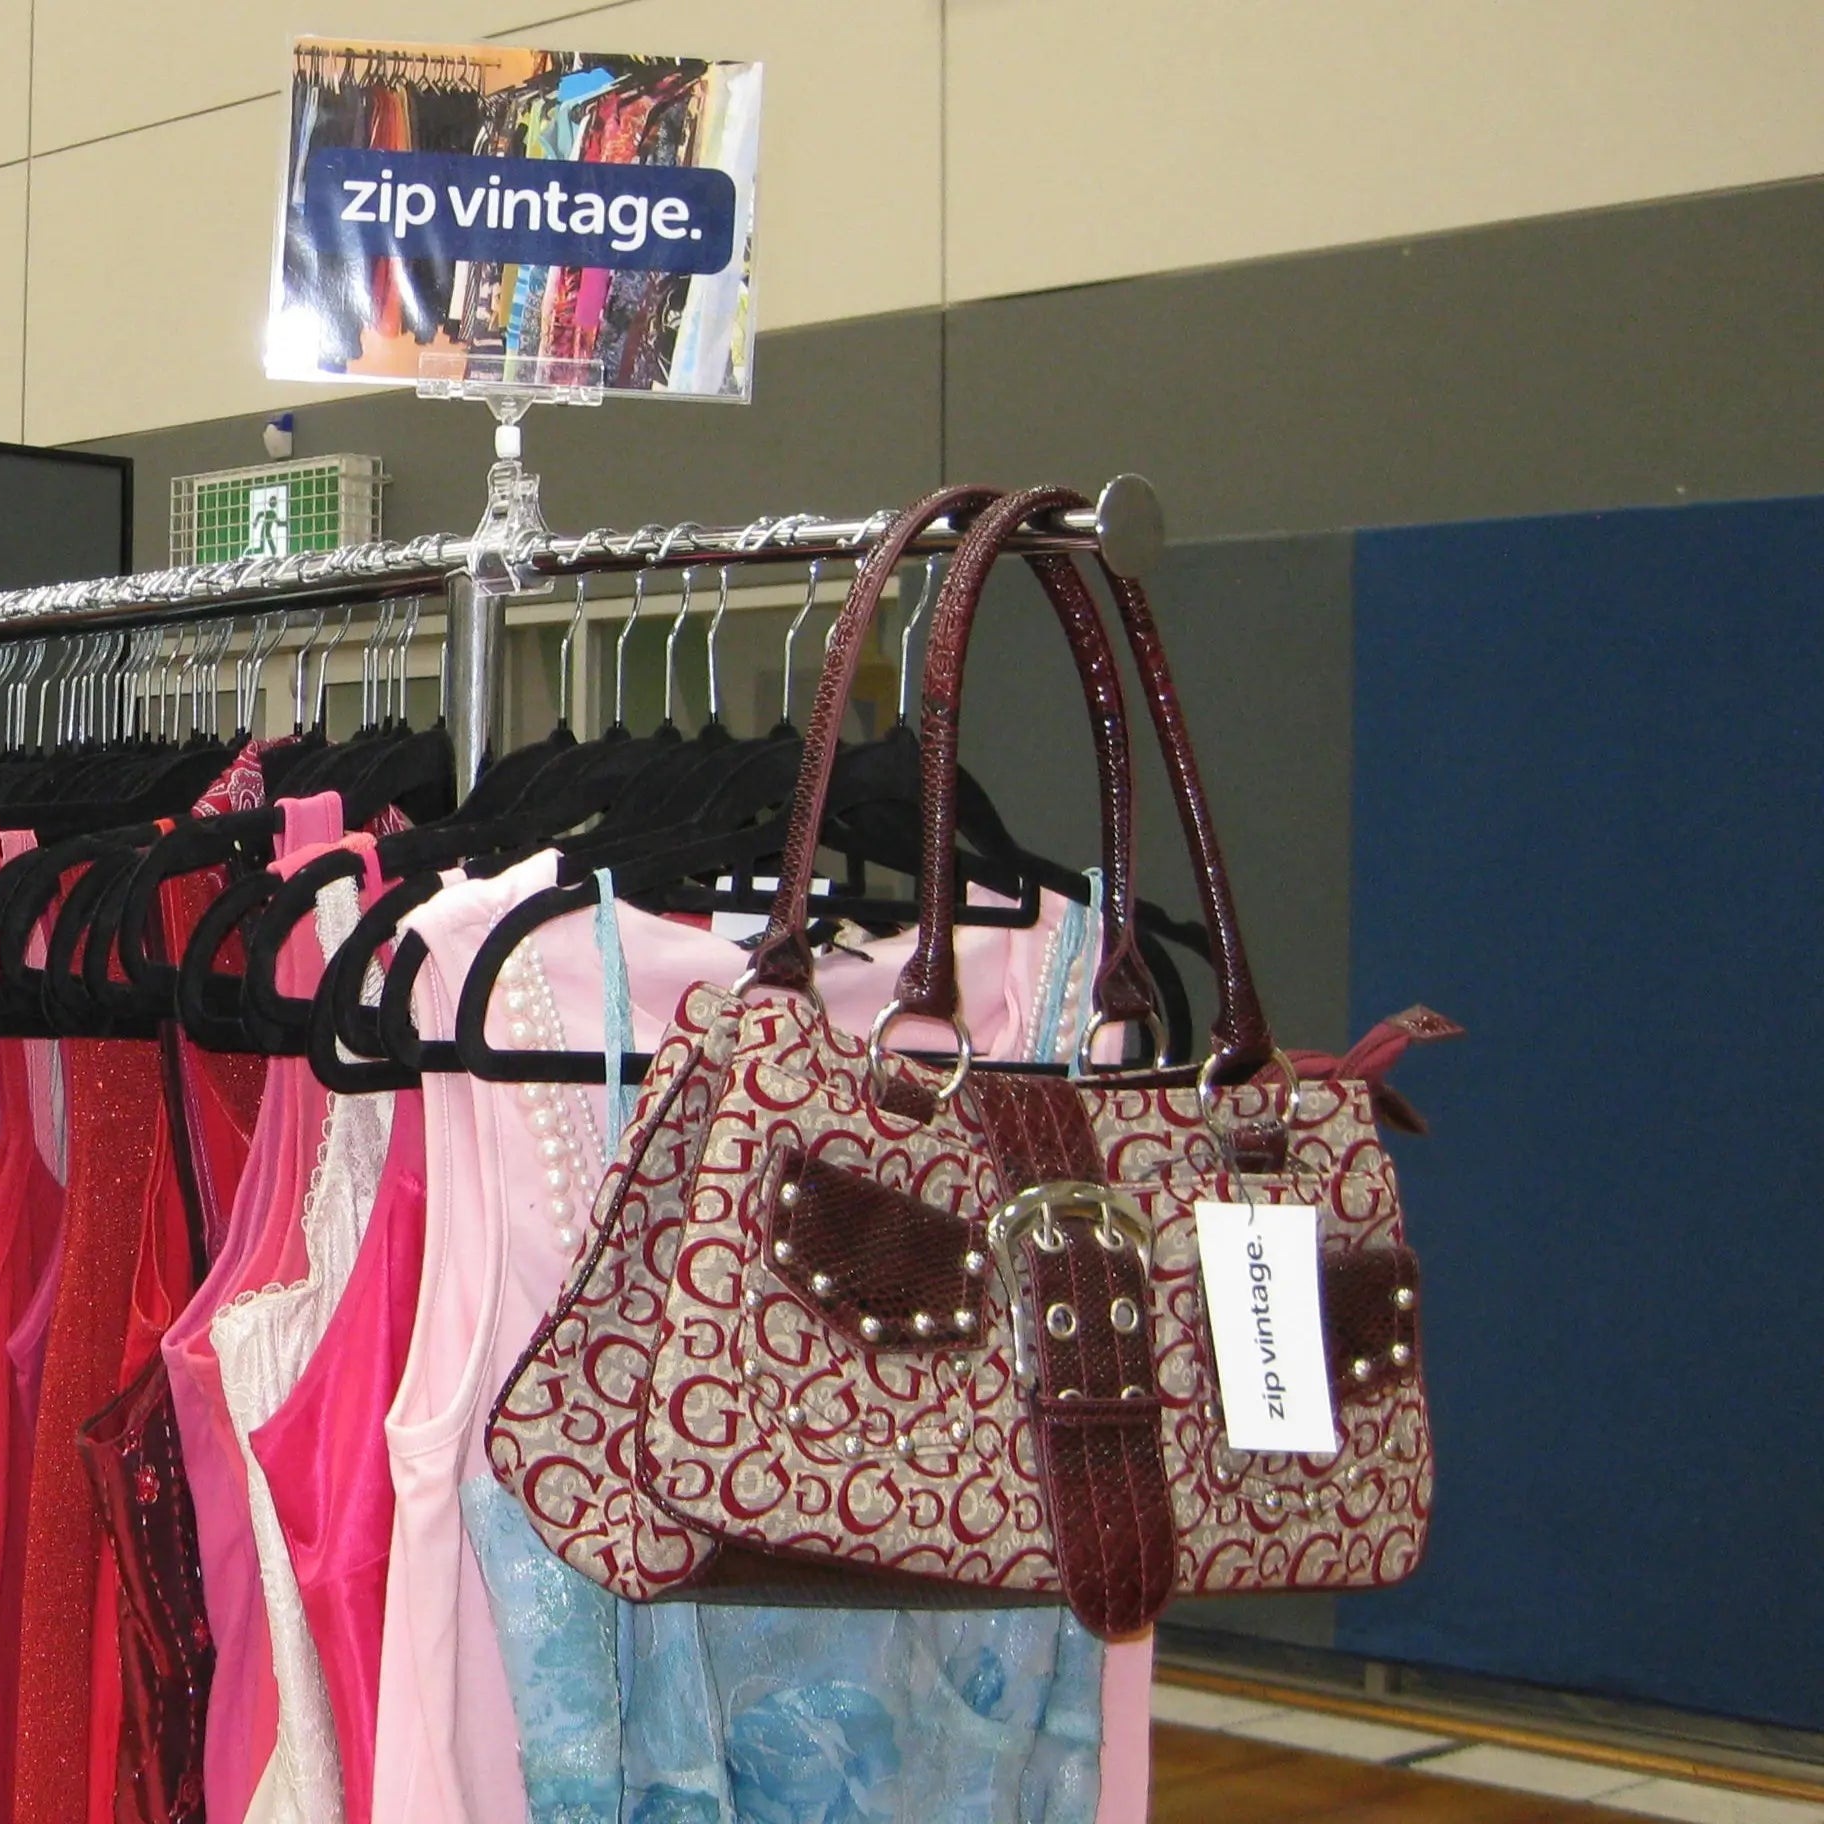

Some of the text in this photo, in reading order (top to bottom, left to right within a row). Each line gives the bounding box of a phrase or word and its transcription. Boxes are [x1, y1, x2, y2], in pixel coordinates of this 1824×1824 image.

[340, 168, 703, 252] zip vintage.
[1246, 1234, 1286, 1420] zip vintage.
